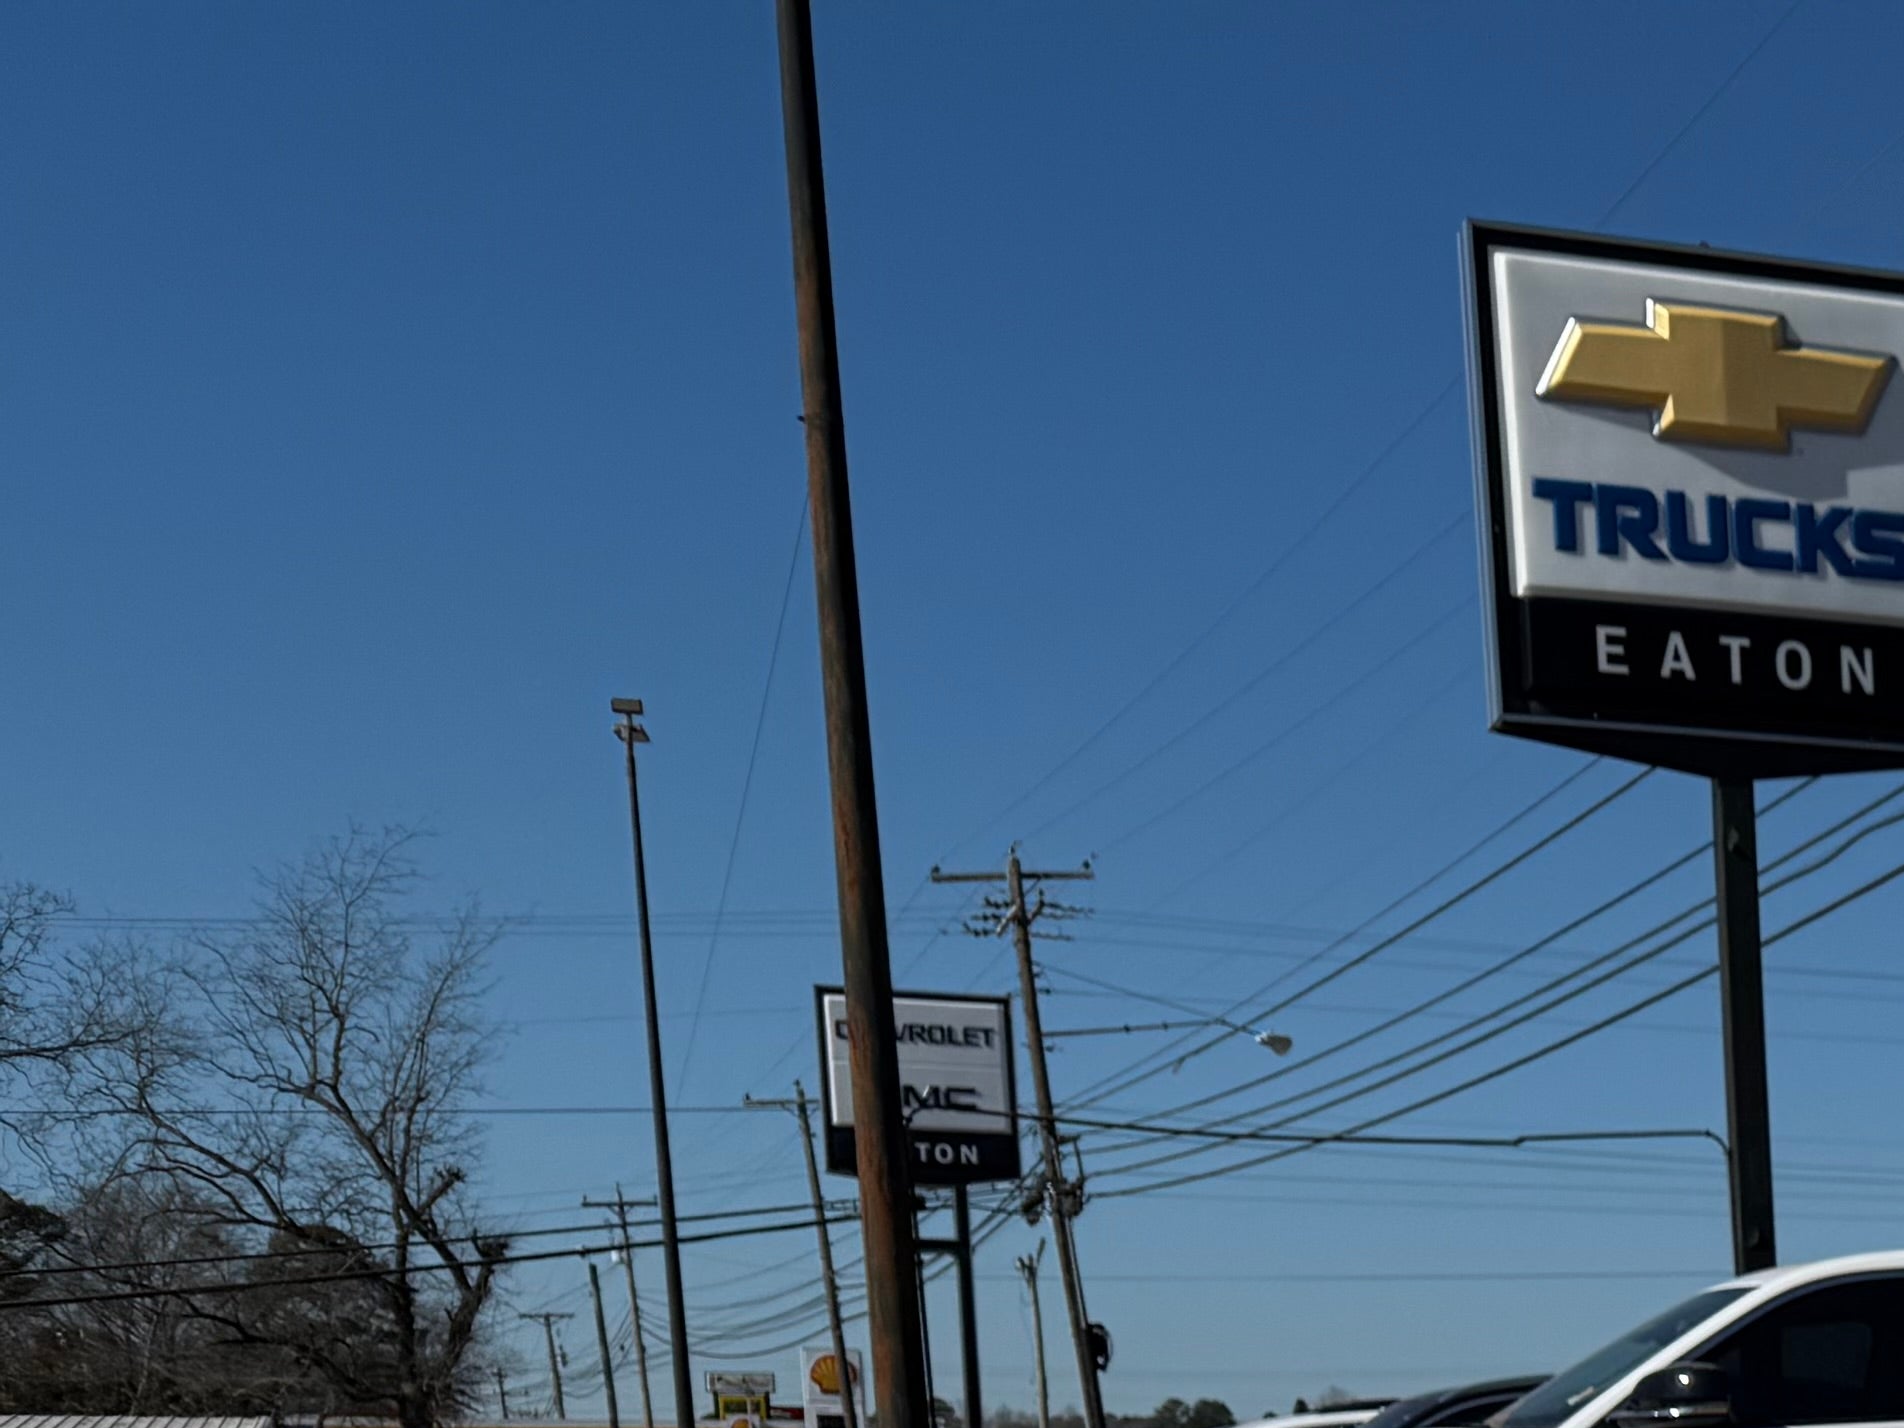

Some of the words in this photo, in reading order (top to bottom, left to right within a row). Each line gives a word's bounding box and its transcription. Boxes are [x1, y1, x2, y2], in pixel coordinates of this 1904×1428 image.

[1595, 623, 1876, 695] EATON
[835, 1019, 996, 1048] CVROLET
[902, 1084, 979, 1110] MC
[914, 1142, 980, 1165] TON
